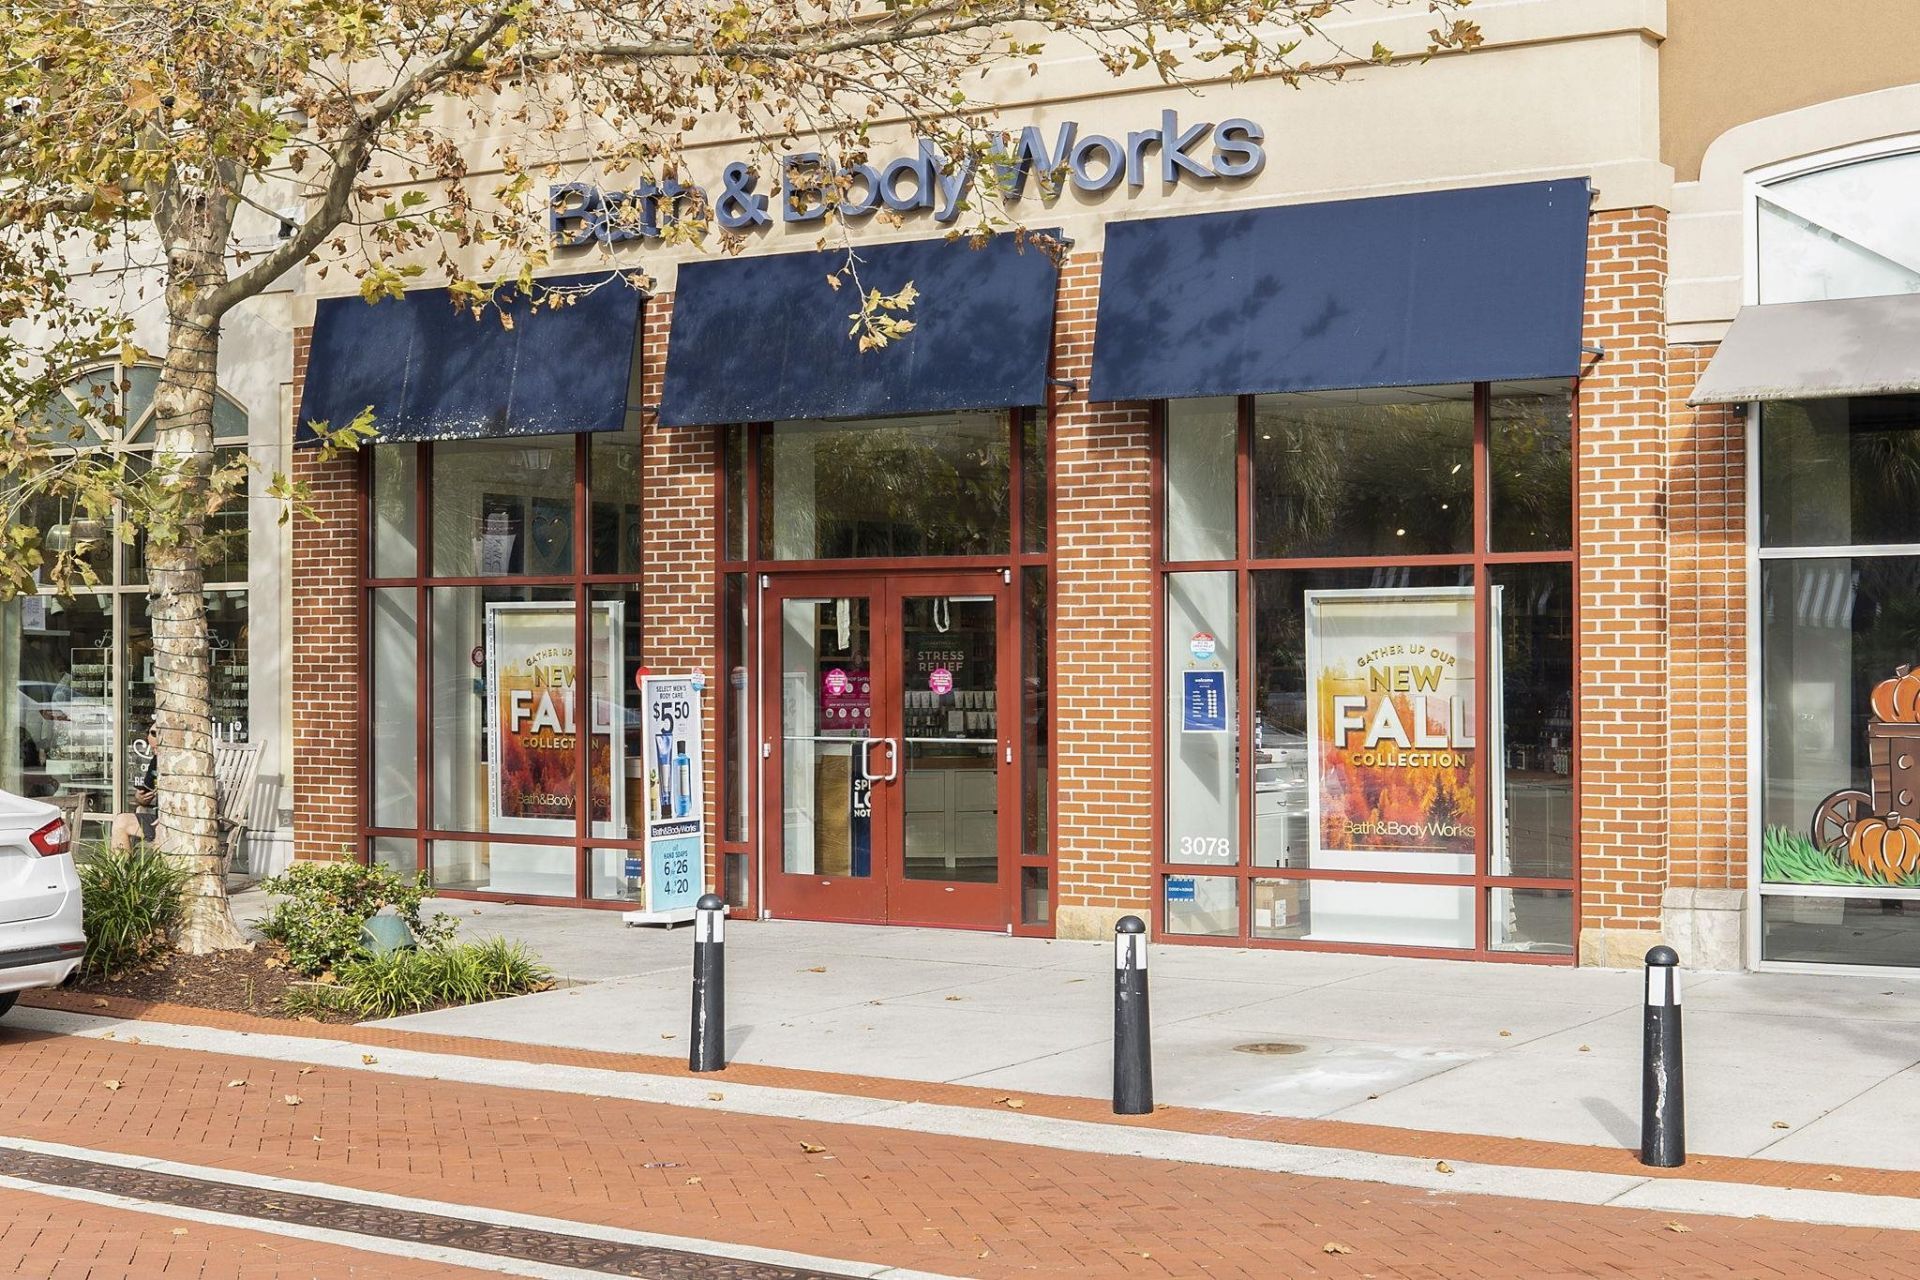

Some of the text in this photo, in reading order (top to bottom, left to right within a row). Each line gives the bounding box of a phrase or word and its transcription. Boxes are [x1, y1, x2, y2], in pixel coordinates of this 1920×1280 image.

[526, 648, 558, 666] GATHER
[917, 651, 965, 661] STRESS
[1357, 644, 1456, 667] GATHER UP OUR
[919, 662, 964, 672] RELIEF
[1369, 665, 1443, 692] NEW
[1333, 694, 1476, 750] FALL
[522, 735, 600, 750] COLLECTN
[1353, 753, 1467, 768] COLLECTION
[1179, 836, 1230, 857] 3078
[664, 861, 670, 876] 6
[664, 881, 671, 895] 4
